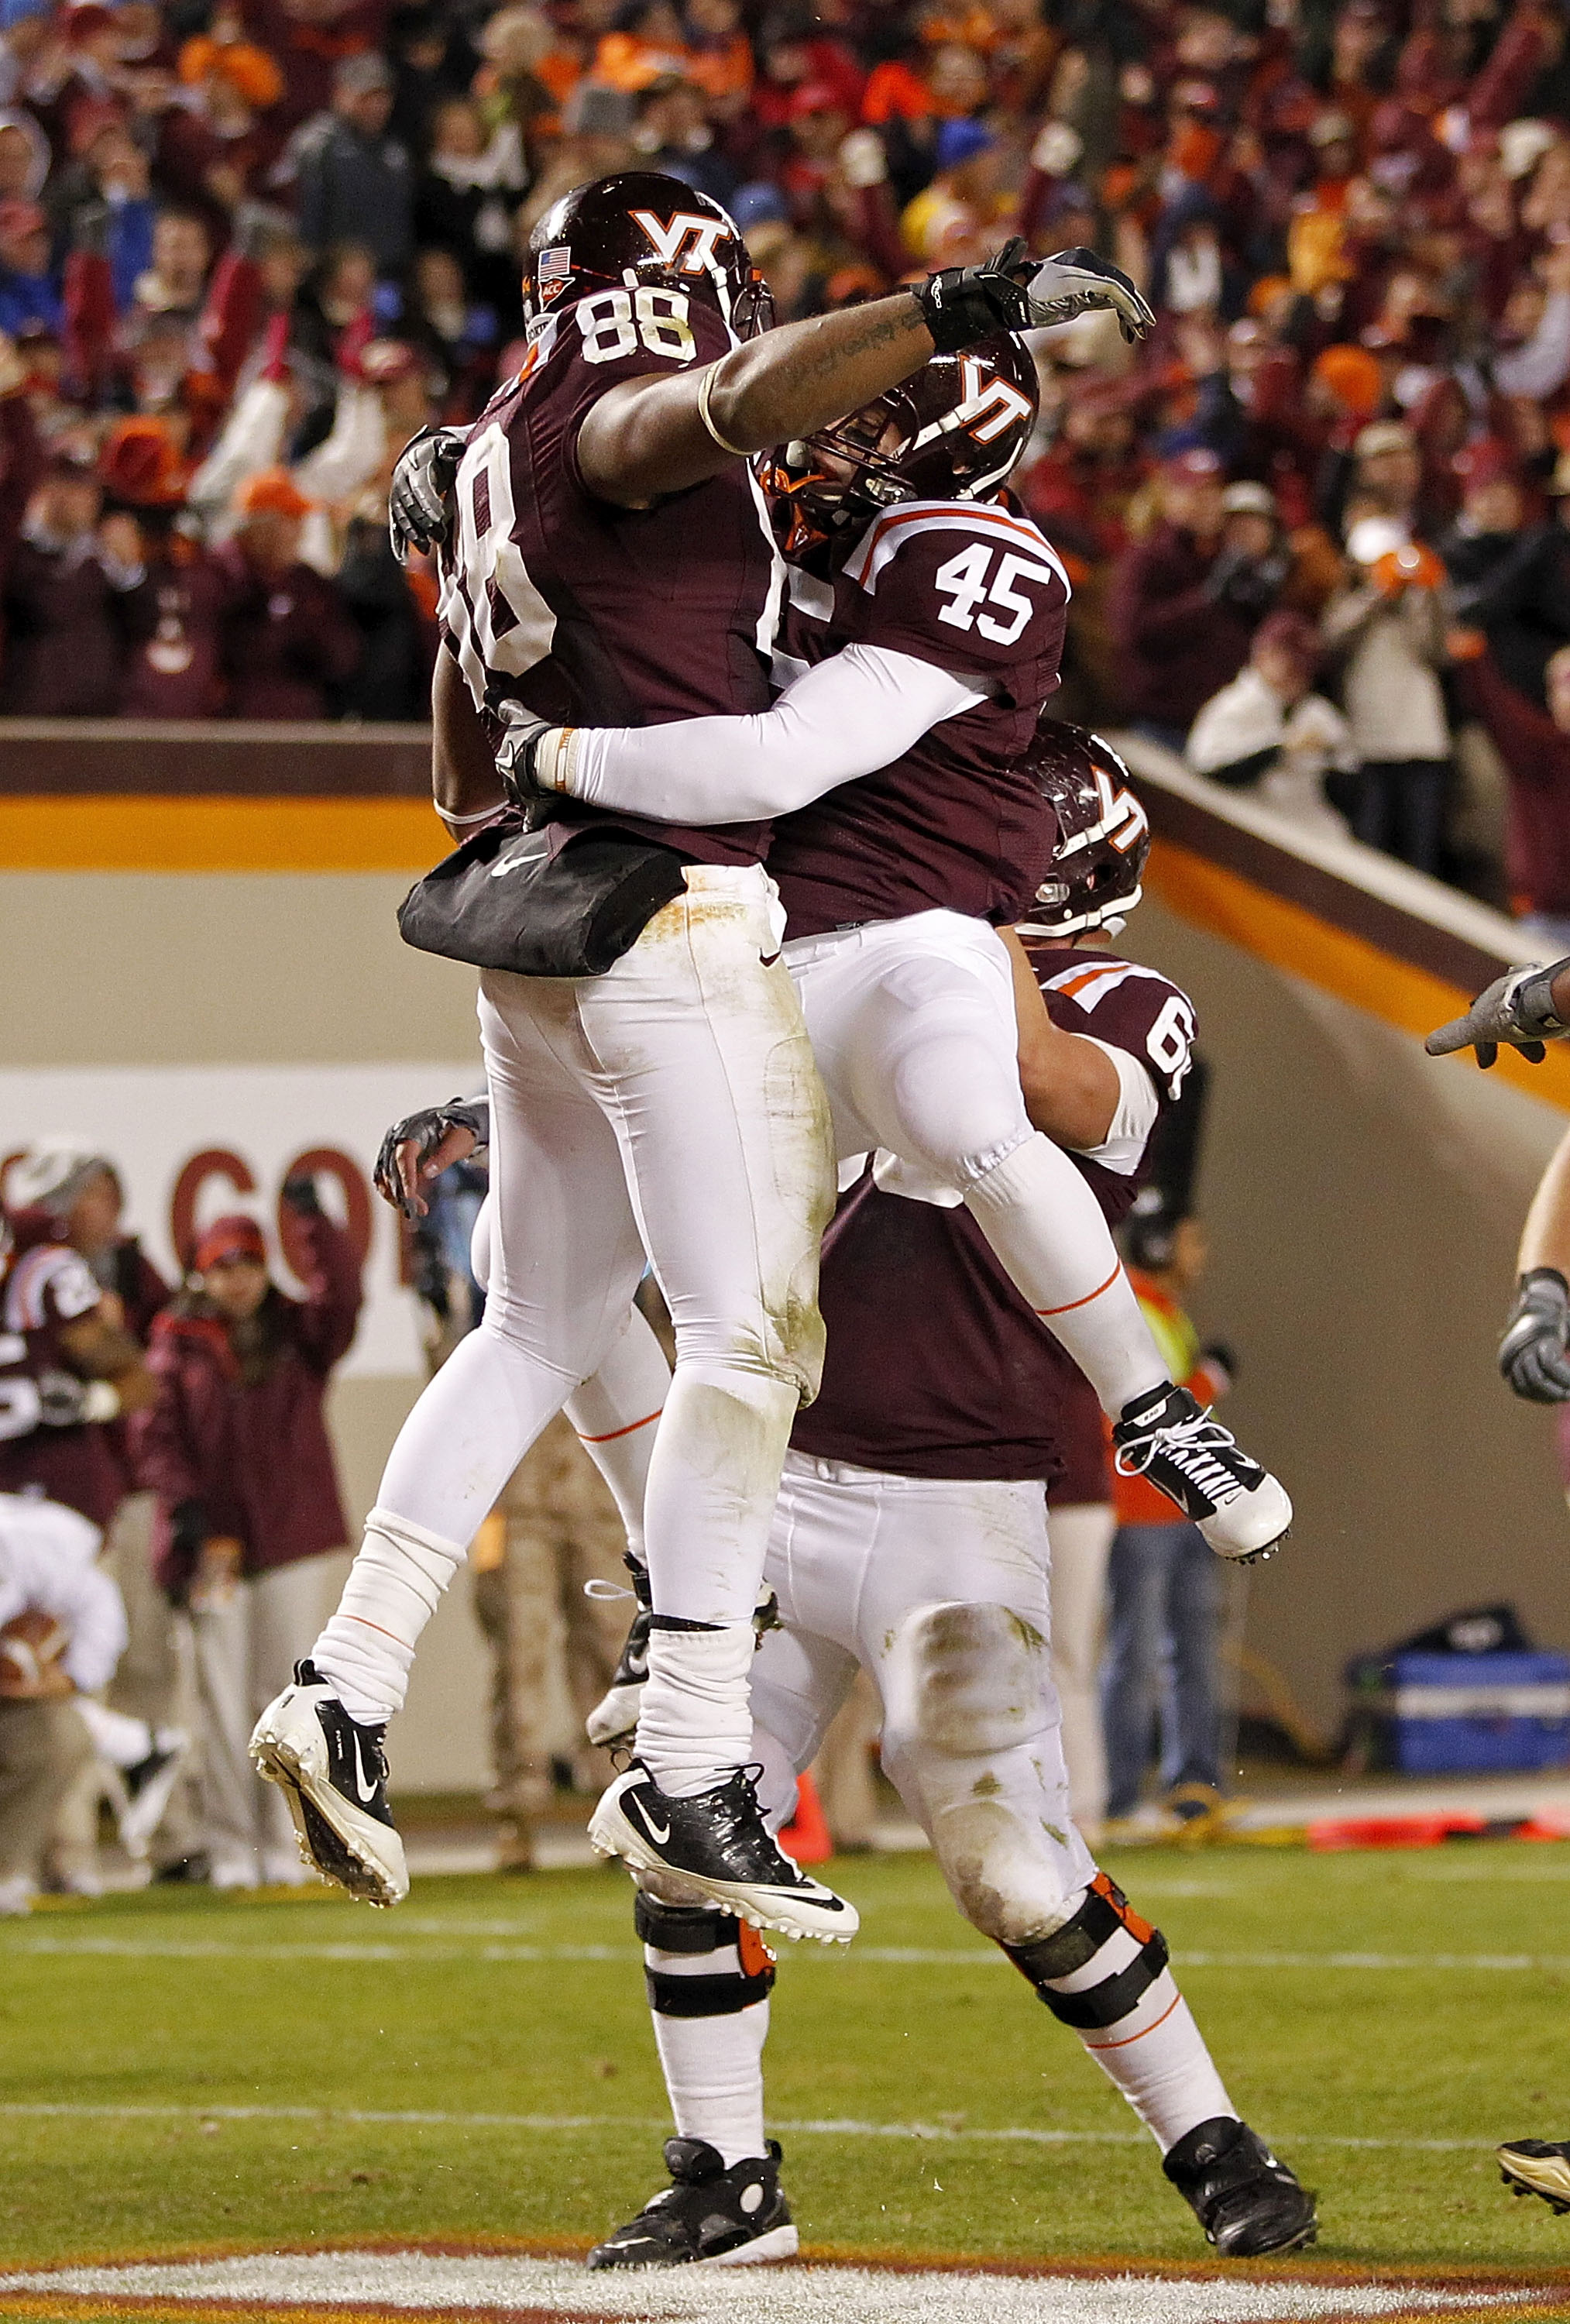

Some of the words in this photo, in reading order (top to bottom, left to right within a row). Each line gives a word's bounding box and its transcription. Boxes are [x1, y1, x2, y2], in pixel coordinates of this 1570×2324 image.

[628, 208, 733, 276] VT
[575, 286, 697, 365] 88
[957, 353, 1034, 445] VT
[935, 542, 1051, 646] 45
[1089, 763, 1149, 854] VT
[1146, 996, 1196, 1094] 6
